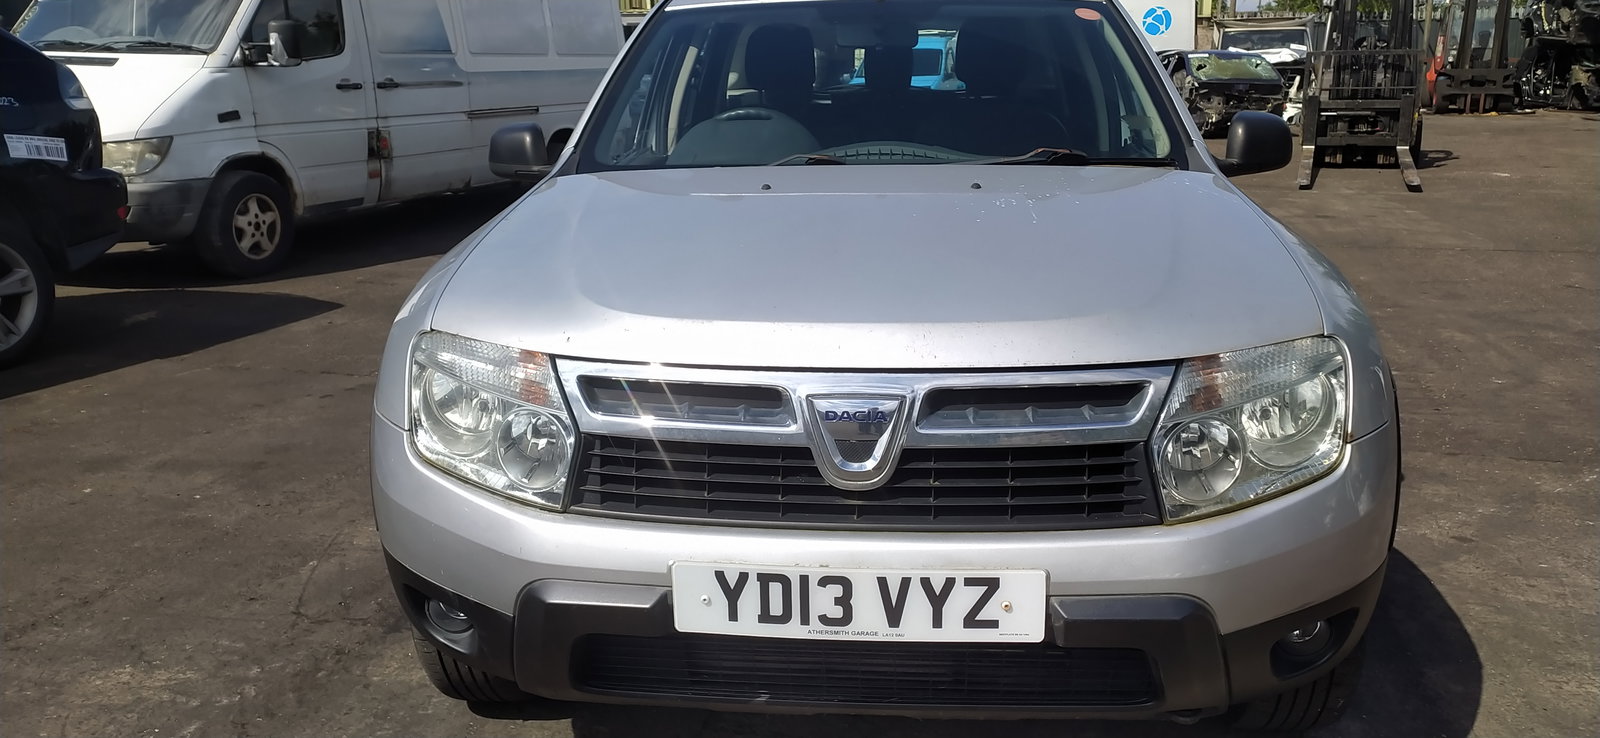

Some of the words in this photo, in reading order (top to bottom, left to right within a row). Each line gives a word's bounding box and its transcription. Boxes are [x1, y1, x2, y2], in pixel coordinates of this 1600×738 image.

[824, 411, 888, 422] DACIA
[714, 570, 854, 628] YD13
[876, 576, 1001, 629] VYZ
